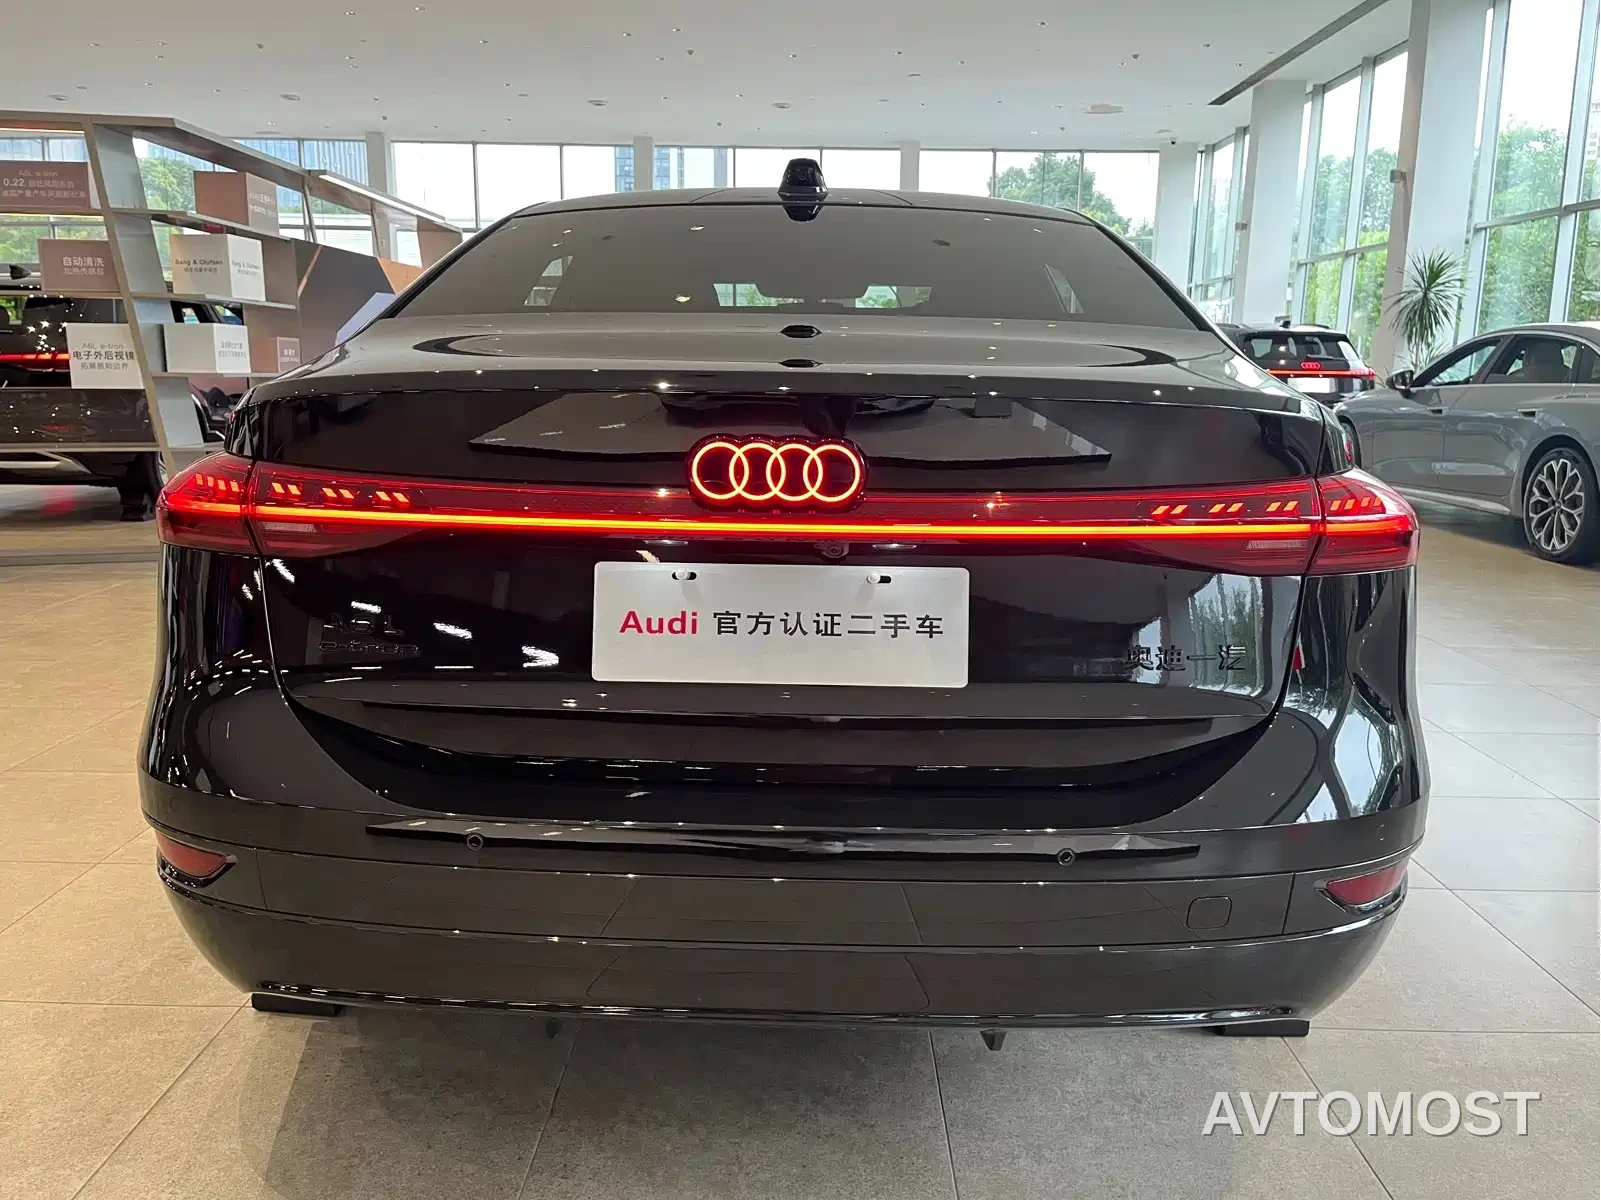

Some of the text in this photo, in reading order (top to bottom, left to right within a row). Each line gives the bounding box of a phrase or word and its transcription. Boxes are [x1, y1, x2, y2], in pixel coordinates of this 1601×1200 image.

[2, 177, 25, 187] 0.22
[62, 256, 105, 267] 自动清洗
[82, 342, 98, 350] A6L
[72, 350, 135, 361] 电子外后视镜
[618, 610, 945, 640] Audi 官方认证二手车
[1125, 644, 1248, 671] 奥迪一汽
